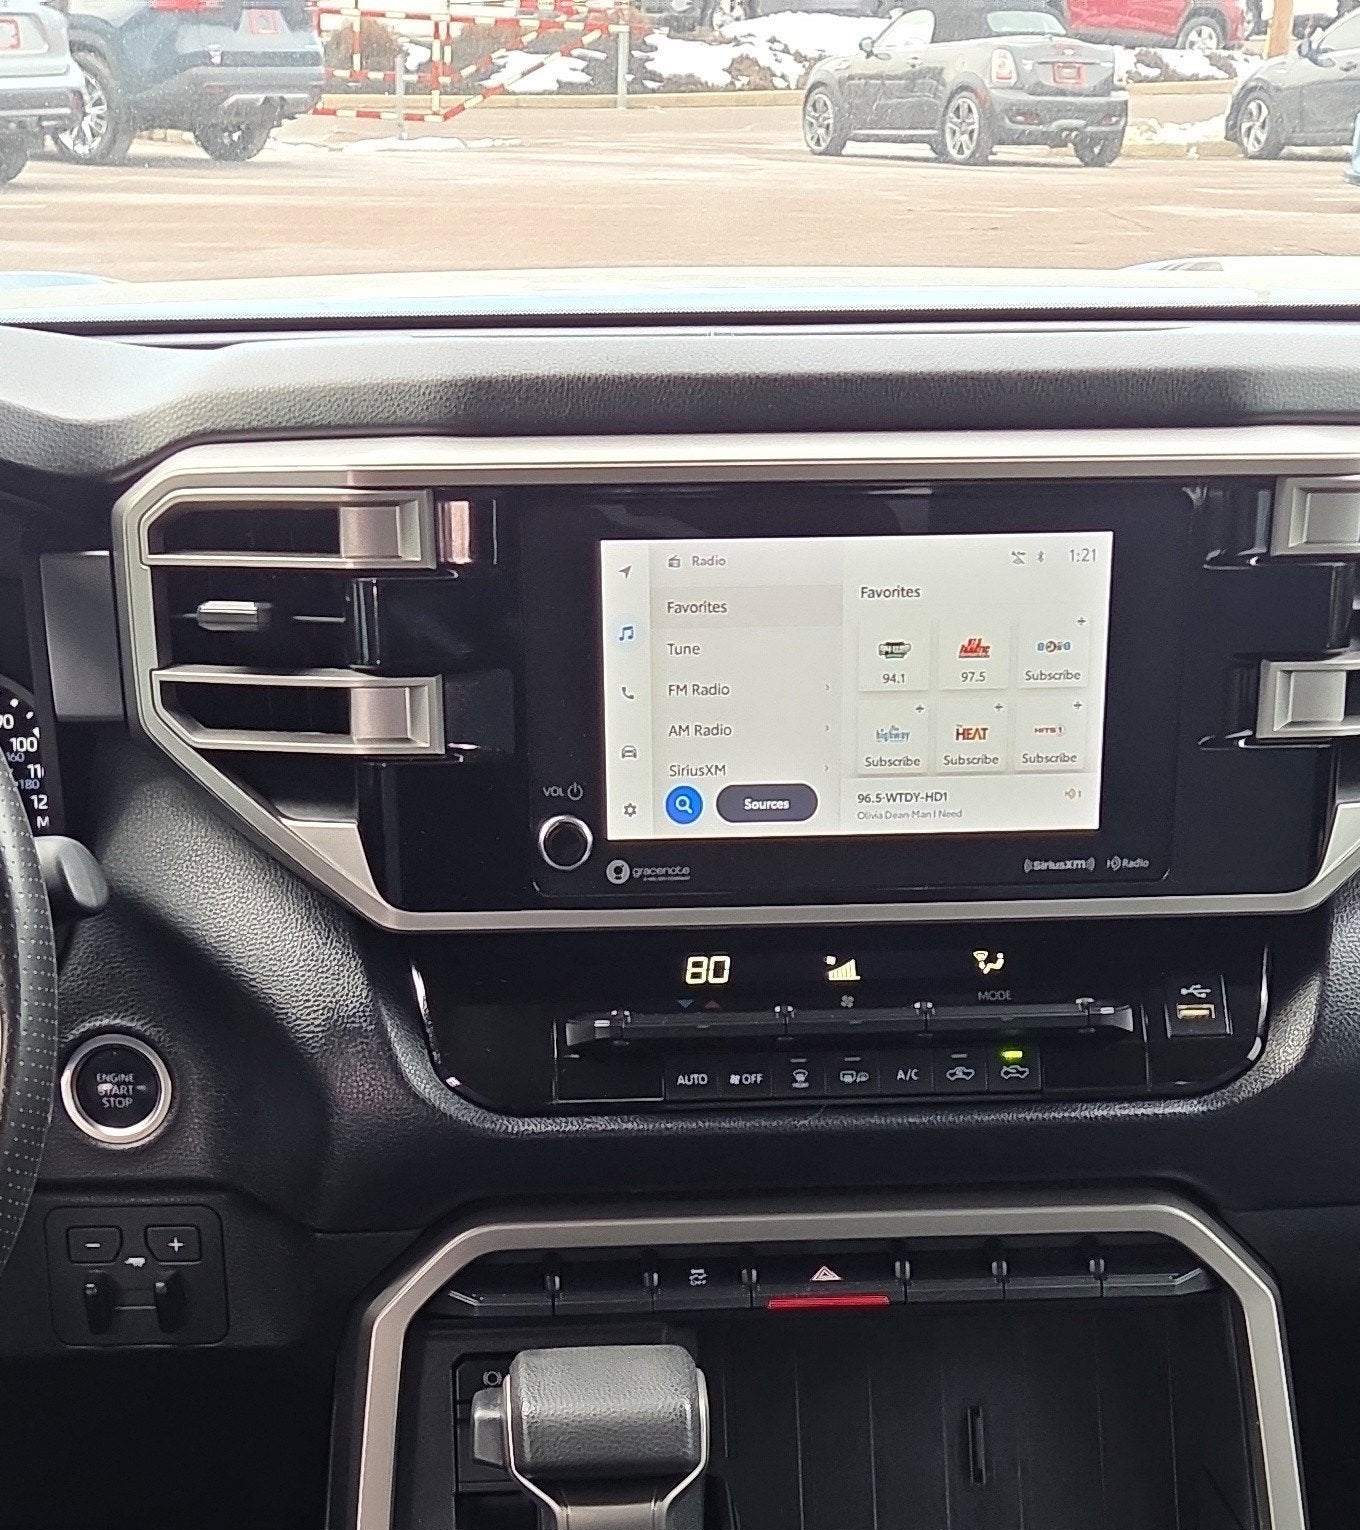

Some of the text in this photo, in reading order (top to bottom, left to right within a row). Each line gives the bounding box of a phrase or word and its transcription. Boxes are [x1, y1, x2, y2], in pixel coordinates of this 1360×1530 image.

[692, 555, 727, 567] Radio
[1069, 548, 1097, 562] 1:21
[860, 586, 921, 598] Favorites
[666, 601, 728, 614] Favorites
[667, 643, 702, 656] Tune
[882, 673, 906, 684] 94.1
[961, 672, 986, 682] 97.5
[1025, 669, 1081, 681] Subscribe
[668, 683, 730, 696] FM Radio
[668, 724, 732, 737] AM Radio
[955, 727, 988, 740] HEAT
[9, 736, 38, 752] 100
[865, 756, 921, 767] Subscribe
[943, 754, 999, 766] Subscribe
[1022, 753, 1077, 764] Subscribe
[669, 764, 726, 777] SiriusXM
[542, 786, 565, 797] VOL
[30, 794, 49, 810] 12
[744, 798, 789, 810] Sources
[36, 815, 50, 828] M
[632, 866, 690, 878] gracenote
[685, 956, 730, 984] 80
[977, 990, 1012, 1001] MODE
[96, 1072, 134, 1083] ENGINE
[677, 1074, 708, 1085] AUTO
[742, 1073, 763, 1085] OFF
[896, 1069, 920, 1081] A/C
[97, 1084, 134, 1096] START
[101, 1096, 134, 1108] STOP
